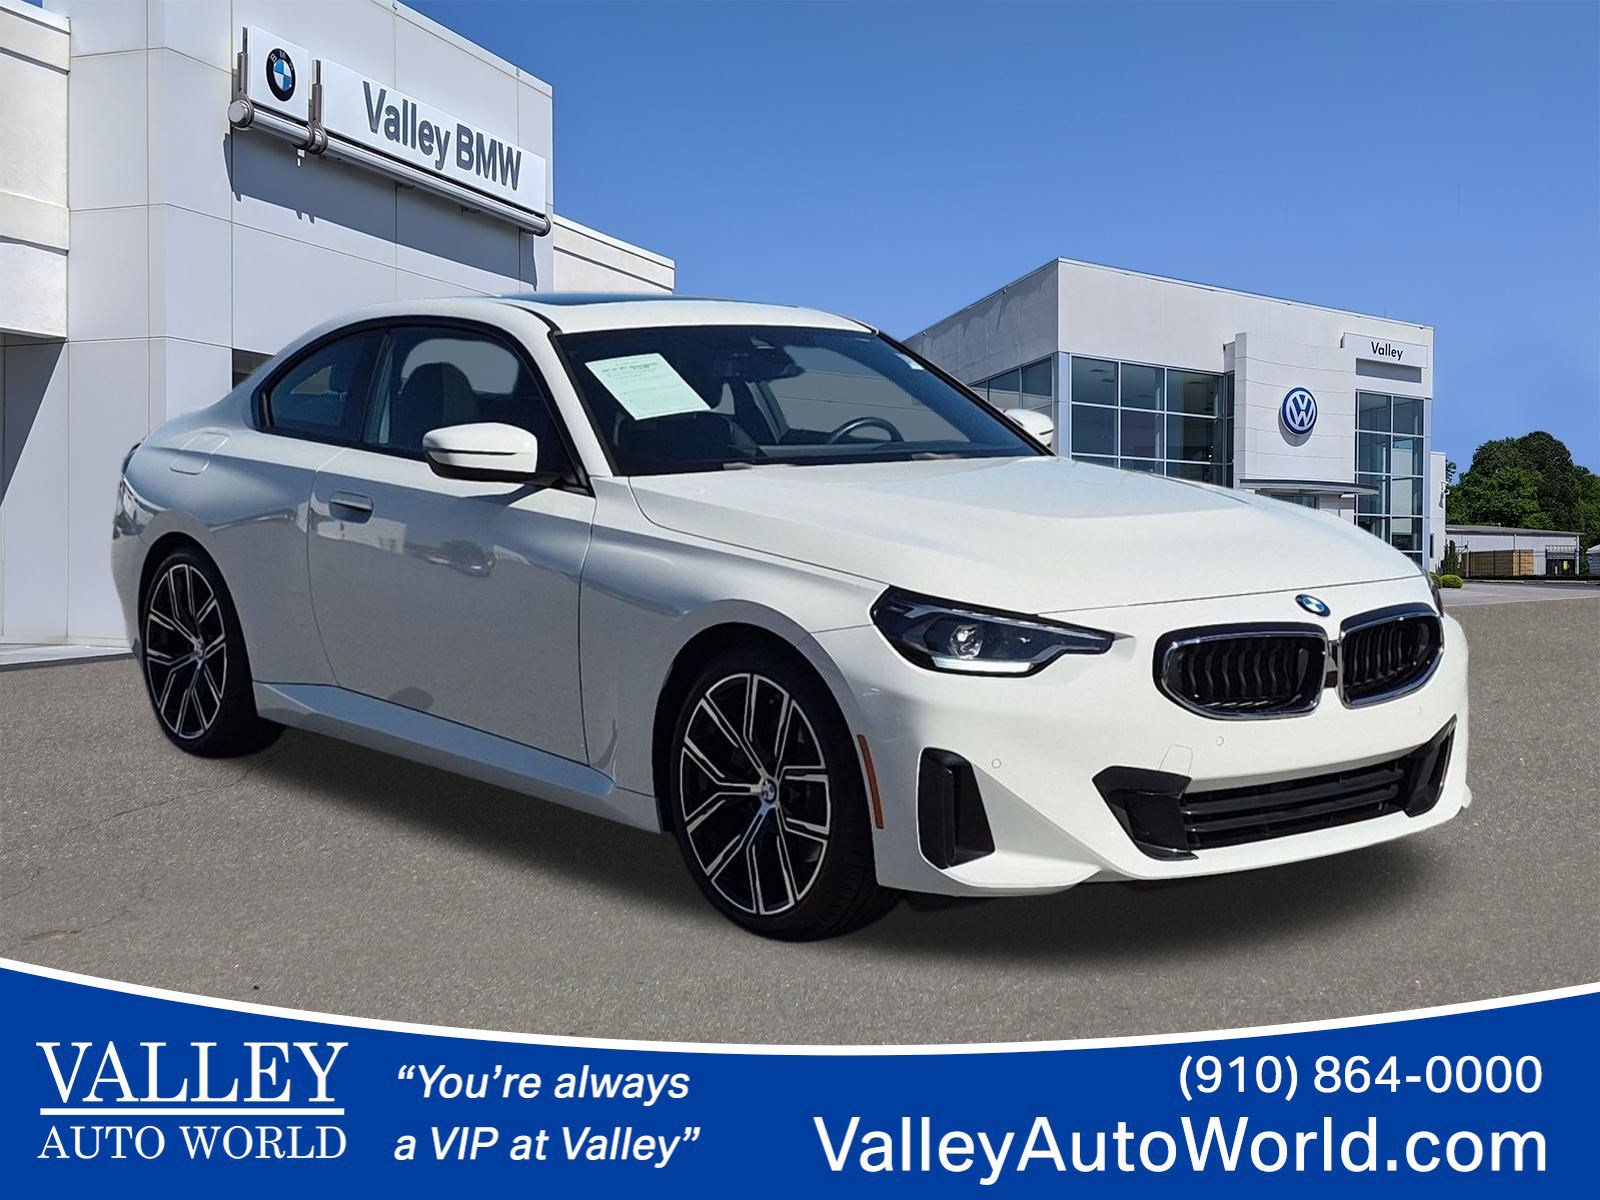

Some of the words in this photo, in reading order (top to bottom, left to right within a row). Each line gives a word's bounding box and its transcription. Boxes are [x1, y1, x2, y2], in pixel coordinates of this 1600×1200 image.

[362, 80, 451, 171] Valley
[455, 122, 523, 191] BMW
[1370, 341, 1404, 361] Valley
